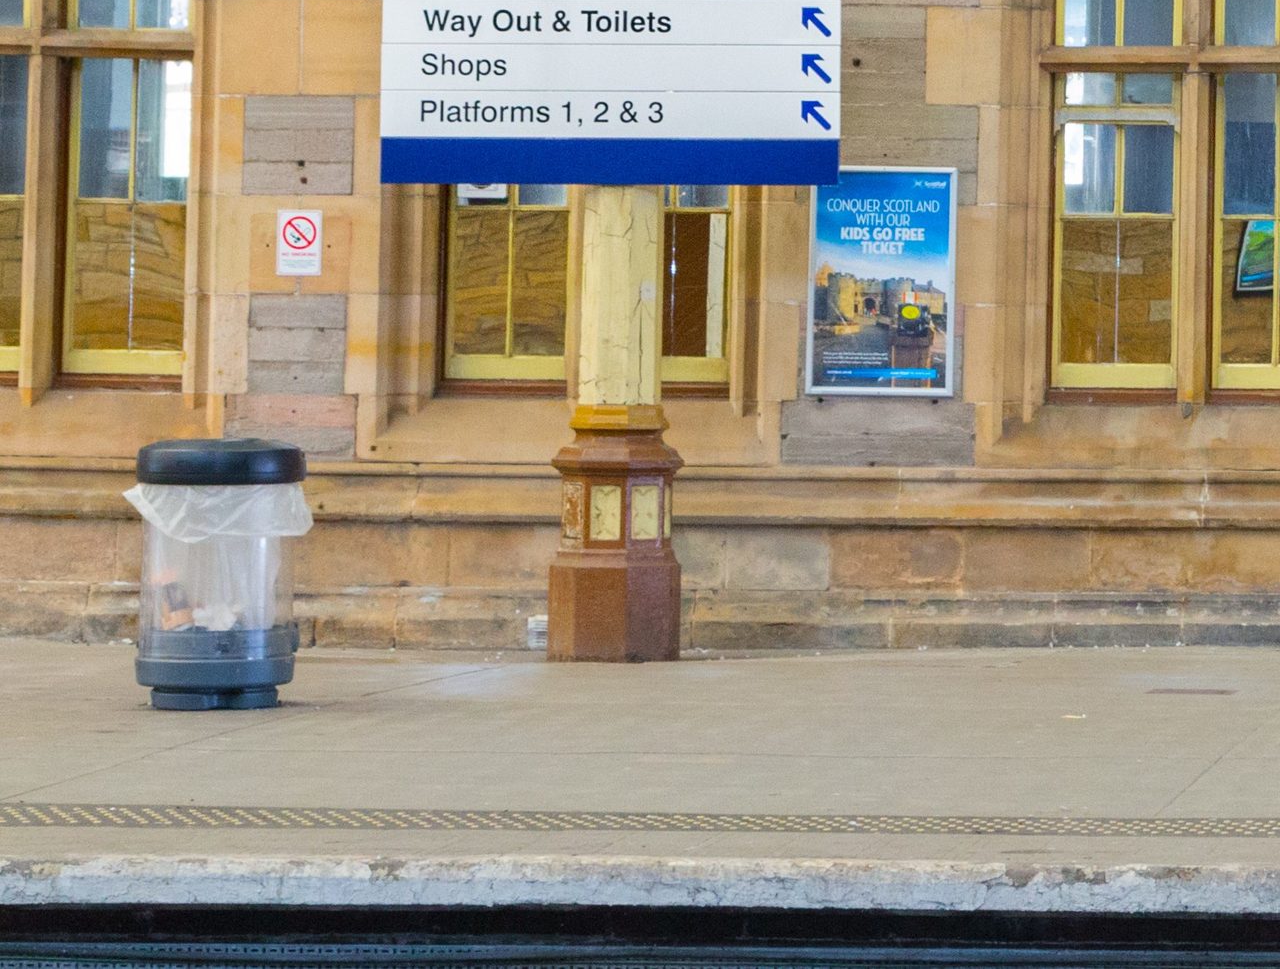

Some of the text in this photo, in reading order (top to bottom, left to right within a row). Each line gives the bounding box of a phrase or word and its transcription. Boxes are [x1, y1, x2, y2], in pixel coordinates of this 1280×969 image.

[423, 9, 672, 38] Way Out & Toilets
[421, 53, 507, 82] Shops
[420, 100, 664, 129] Platforms 1, 2 & 3
[827, 198, 939, 213] CONQUER SCOTLAND
[856, 213, 910, 226] WITH OUR
[840, 228, 924, 241] KIDS GO FREE
[861, 241, 904, 254] TICKET
